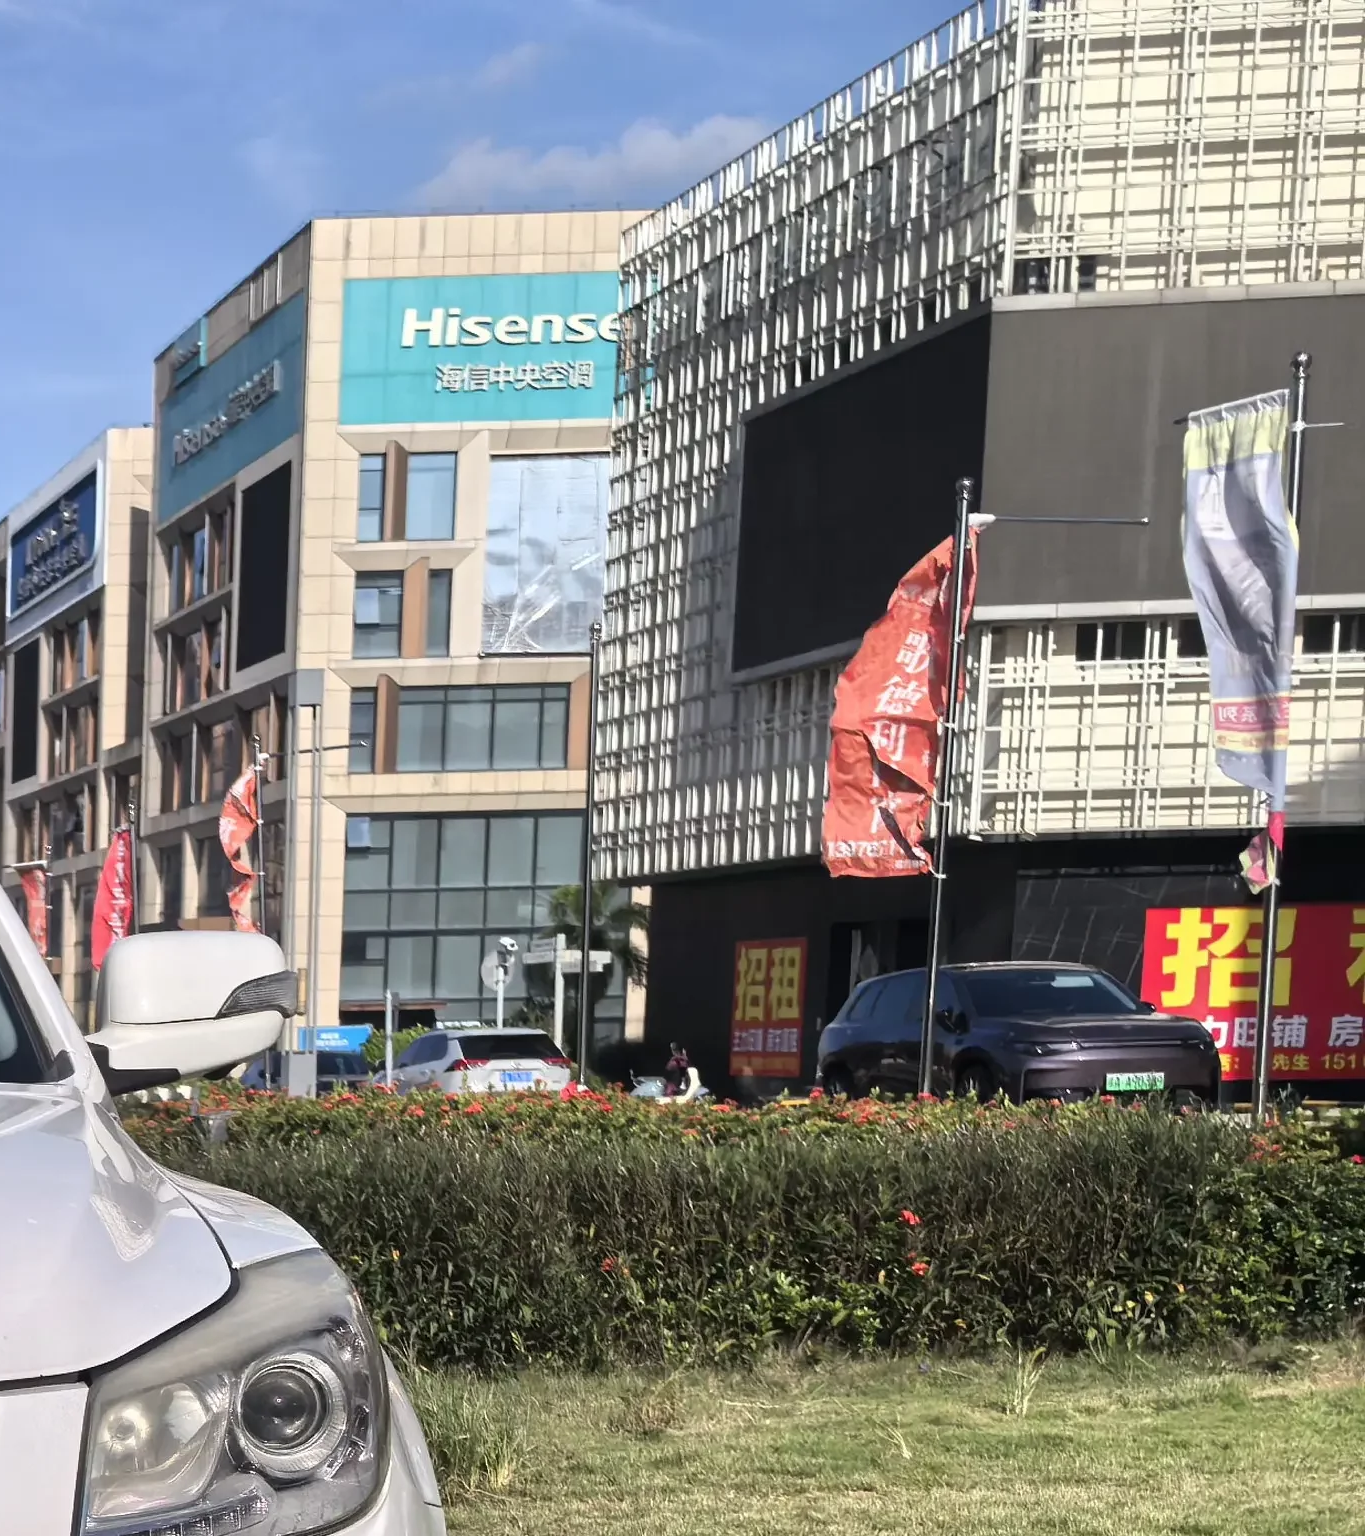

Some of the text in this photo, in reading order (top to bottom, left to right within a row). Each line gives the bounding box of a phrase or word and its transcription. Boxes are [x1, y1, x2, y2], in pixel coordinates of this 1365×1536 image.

[401, 307, 620, 349] Hisense
[435, 361, 594, 393] 海信中央空调
[736, 946, 801, 1021] 招租
[1320, 1053, 1365, 1071] 151
